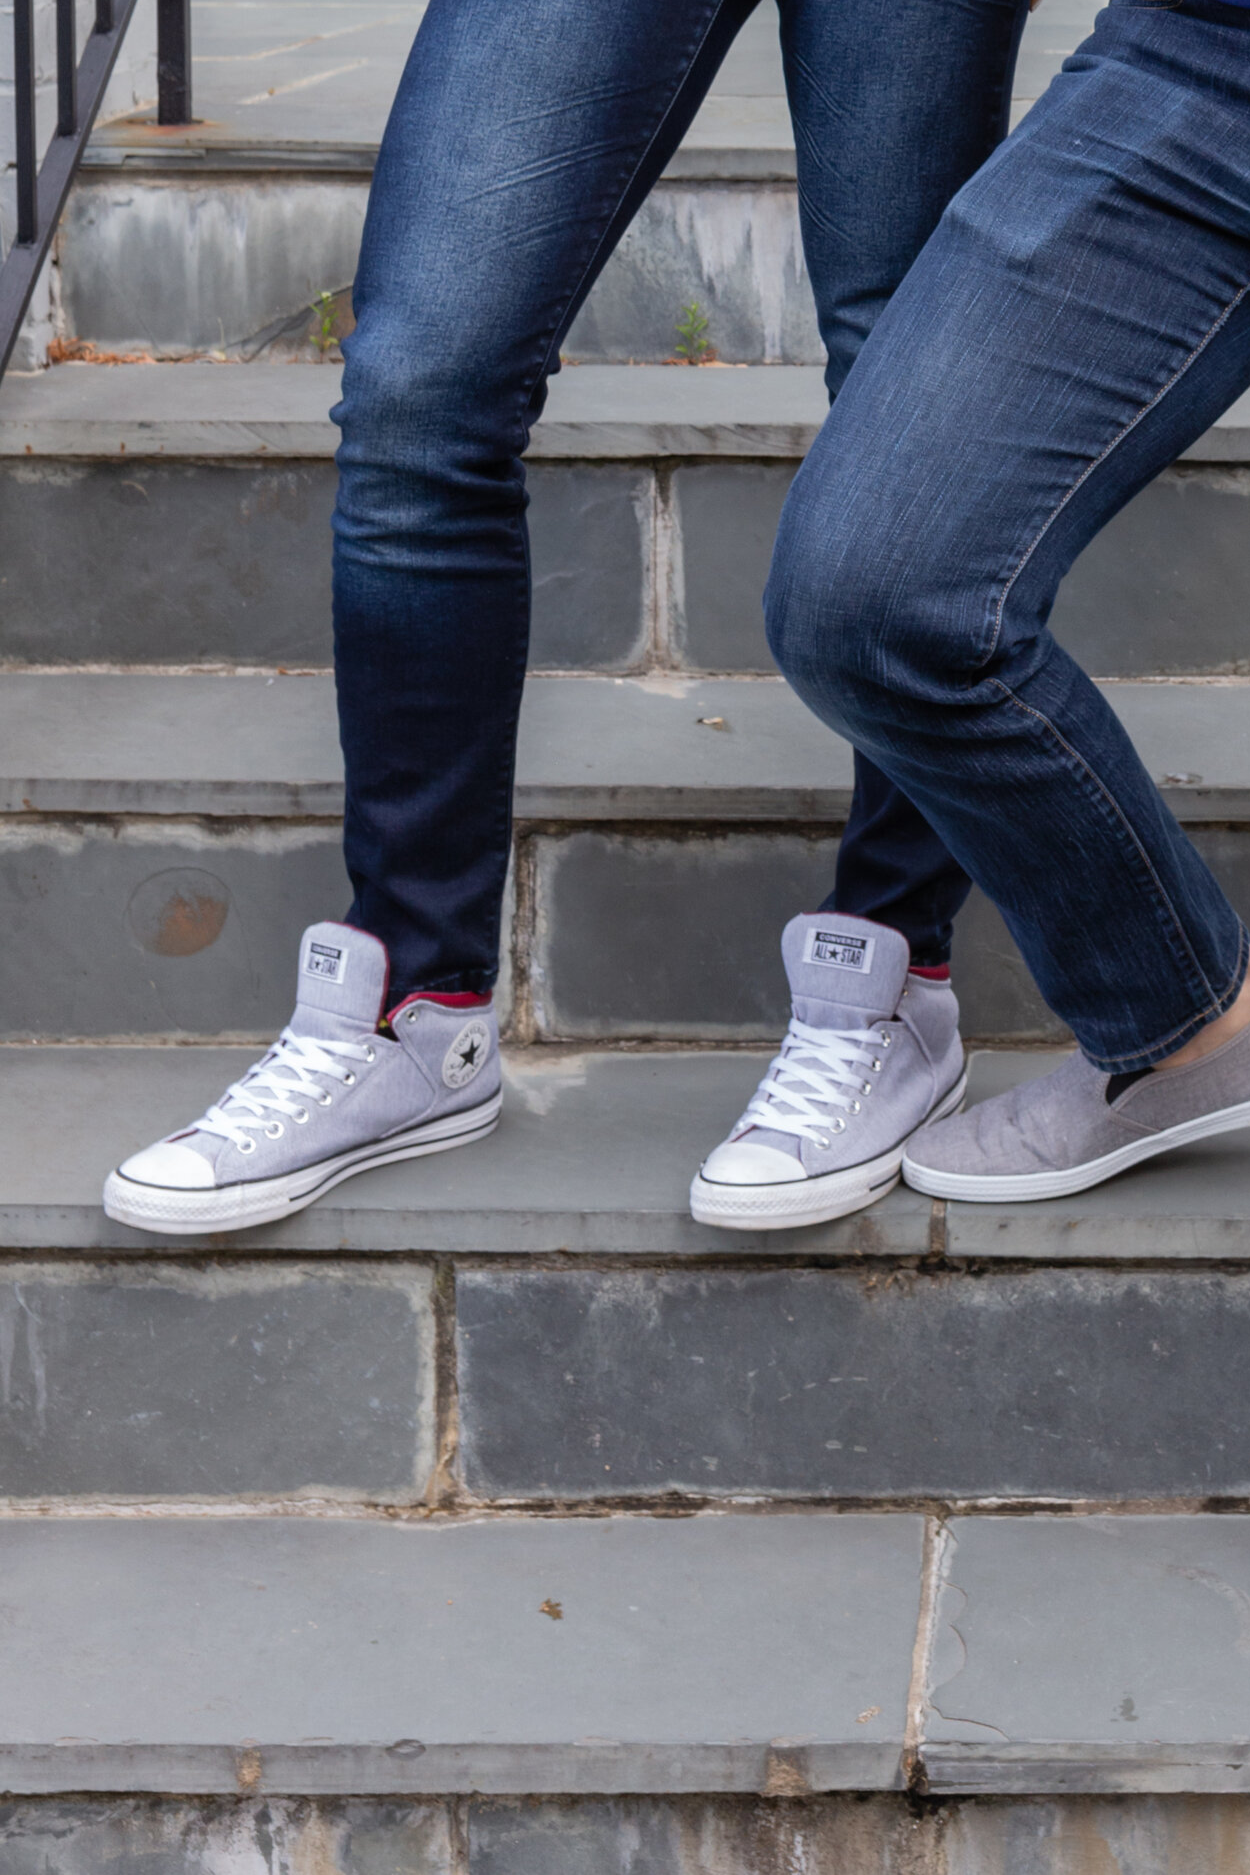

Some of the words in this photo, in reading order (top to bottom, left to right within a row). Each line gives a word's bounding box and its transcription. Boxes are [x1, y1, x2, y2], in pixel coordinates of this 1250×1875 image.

[818, 933, 862, 948] CONVERSE
[814, 943, 828, 959] ALL
[840, 947, 862, 966] STAR
